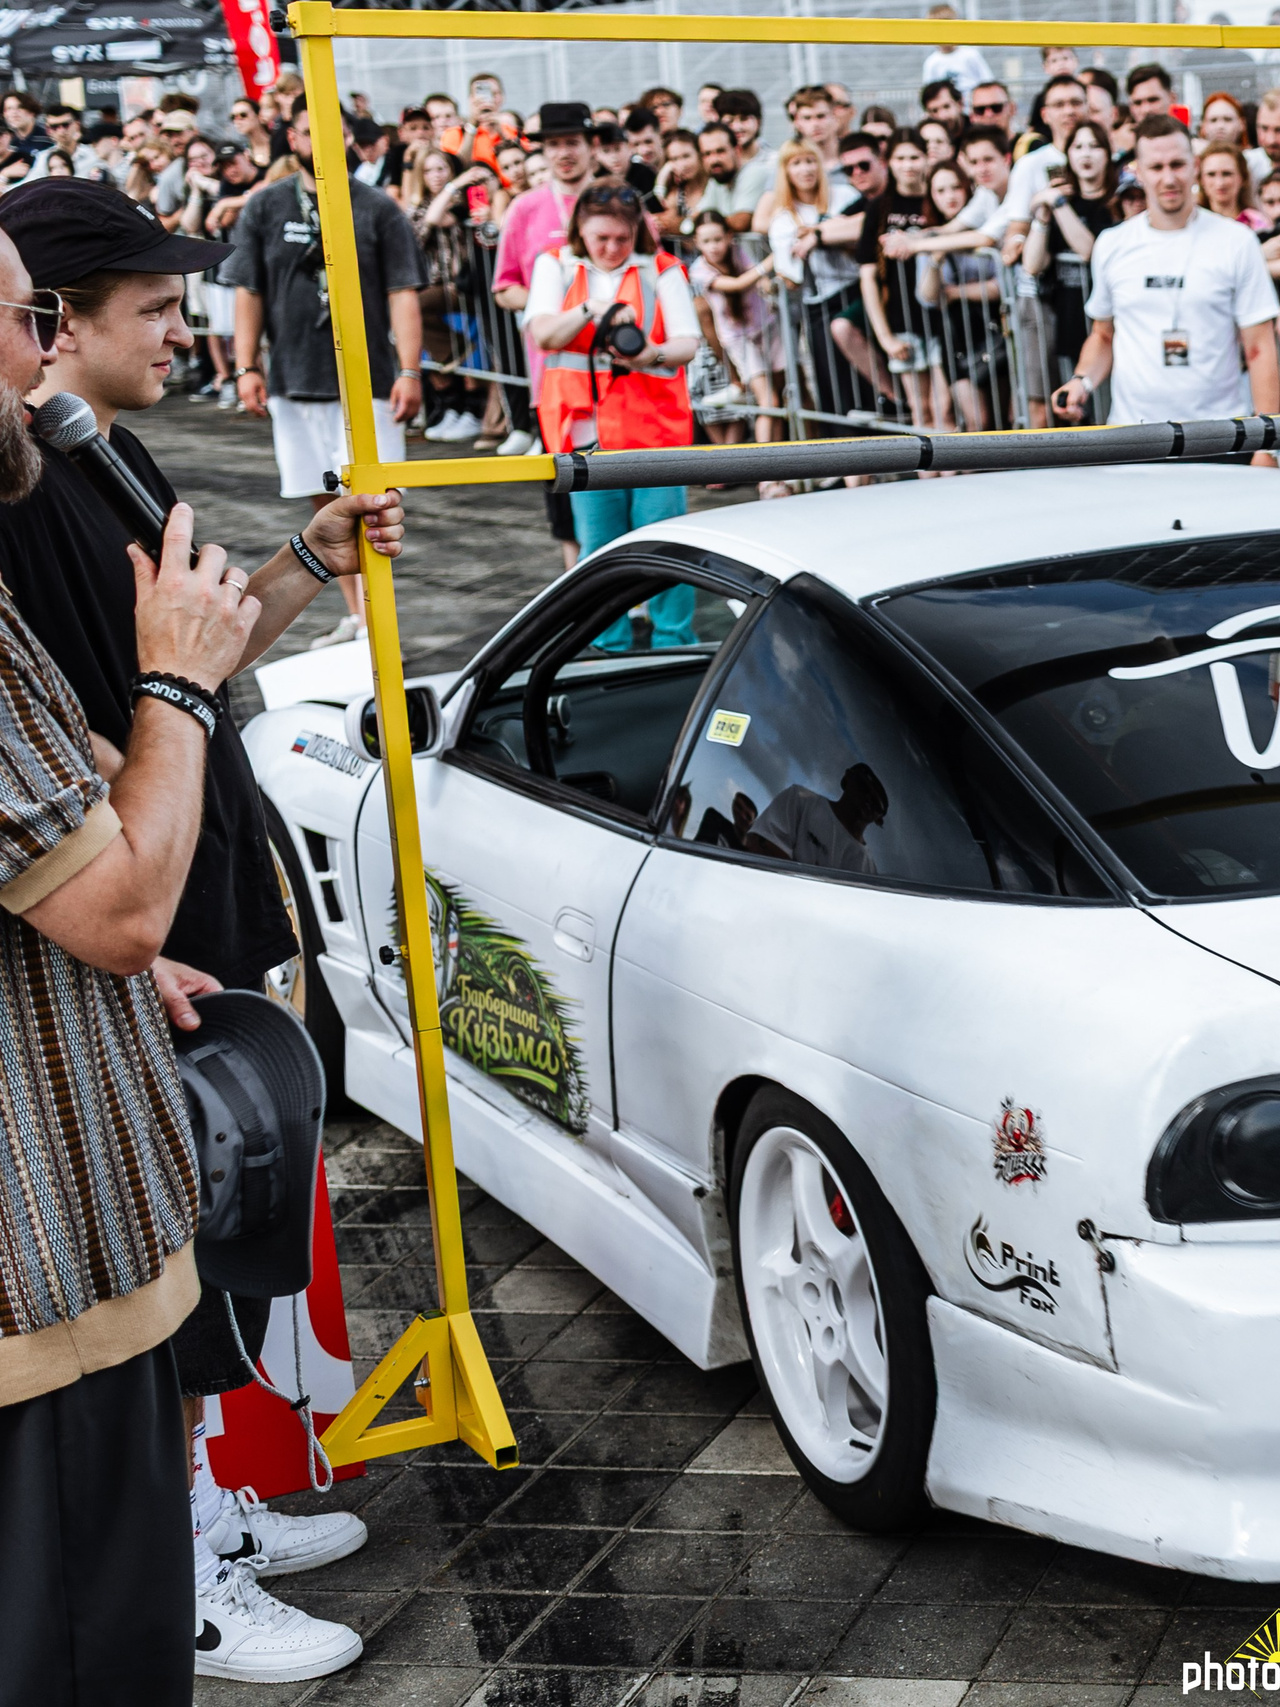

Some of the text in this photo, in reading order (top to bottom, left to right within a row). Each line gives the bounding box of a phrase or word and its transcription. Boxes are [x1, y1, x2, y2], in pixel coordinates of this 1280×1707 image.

[457, 974, 541, 1033] Барбершоп
[449, 1007, 560, 1076] Кузьма
[1001, 1241, 1061, 1288] Print
[1020, 1285, 1055, 1315] Fox
